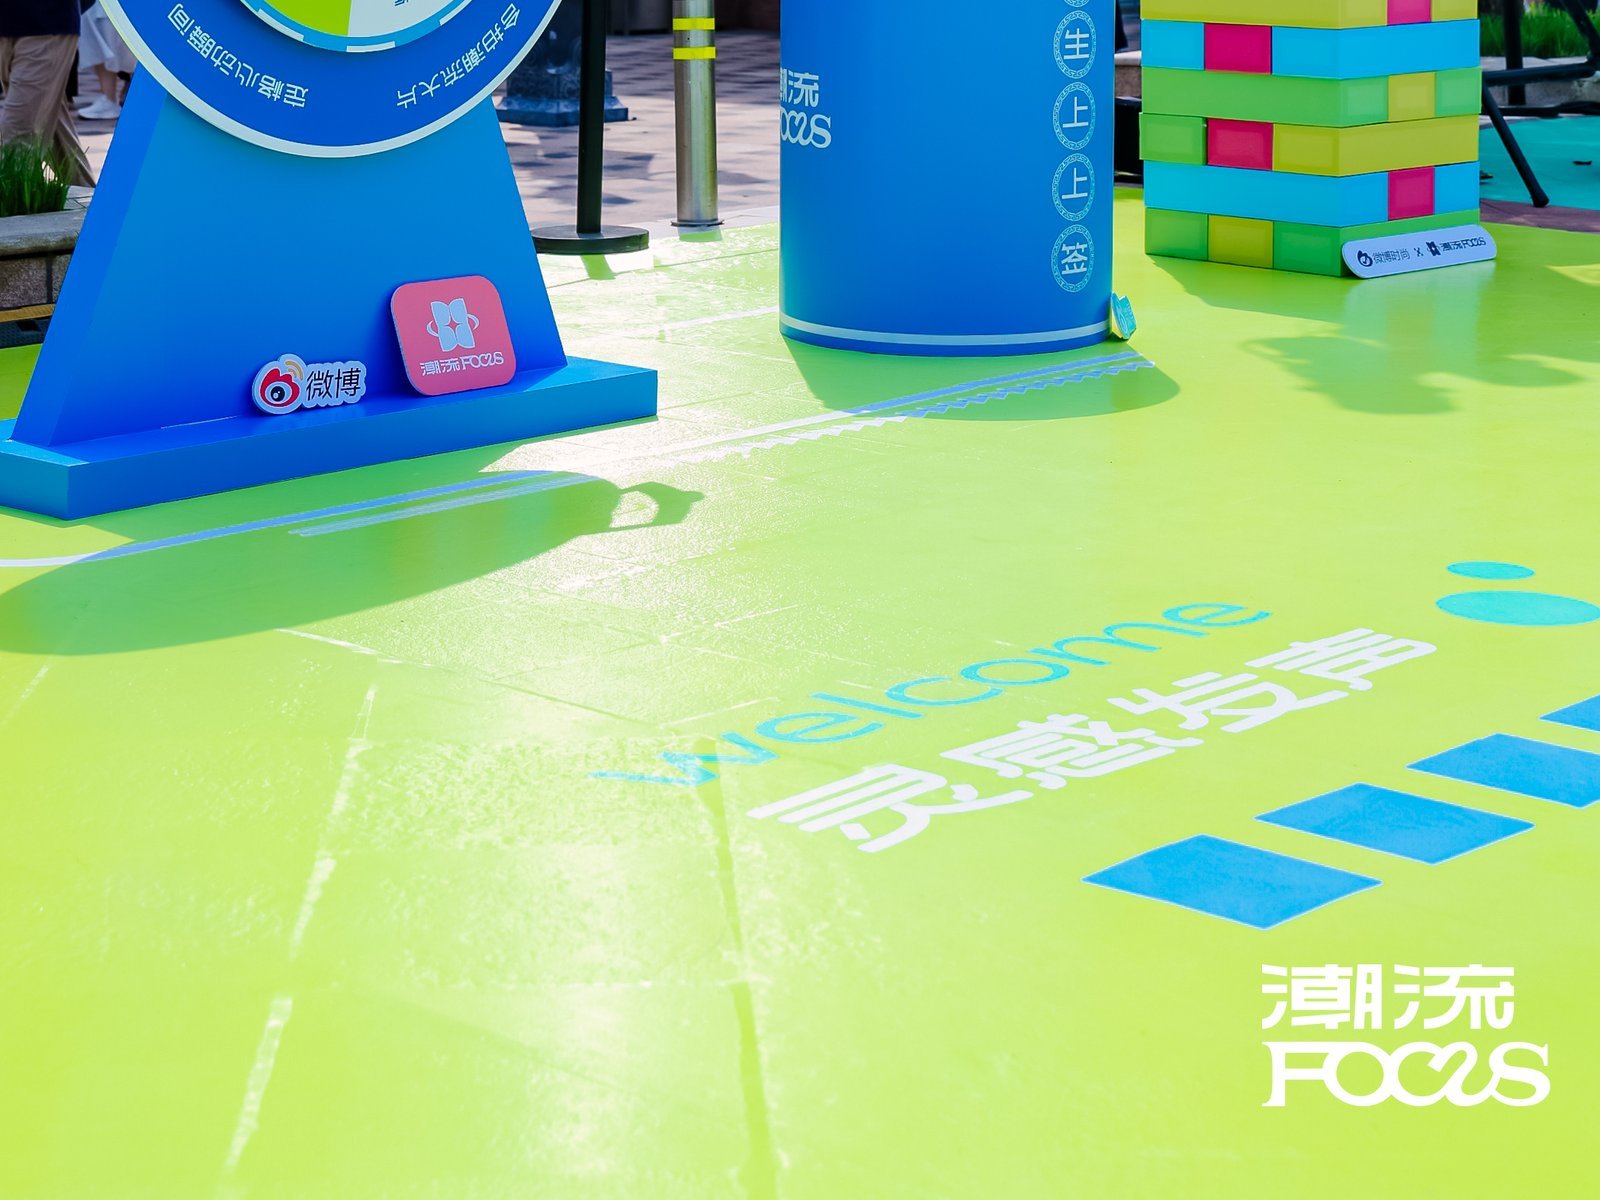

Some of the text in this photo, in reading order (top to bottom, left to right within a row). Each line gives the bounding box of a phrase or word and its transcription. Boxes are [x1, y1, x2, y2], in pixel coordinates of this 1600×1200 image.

[166, 2, 310, 109] 定格心动瞬间
[395, 2, 522, 110] 合拍潮流大片
[780, 106, 832, 149] OCUS
[305, 367, 362, 401] 微博
[419, 351, 505, 377] 潮流 FOCUS
[586, 600, 1271, 788] welcome
[745, 627, 1438, 853] 灵感发声
